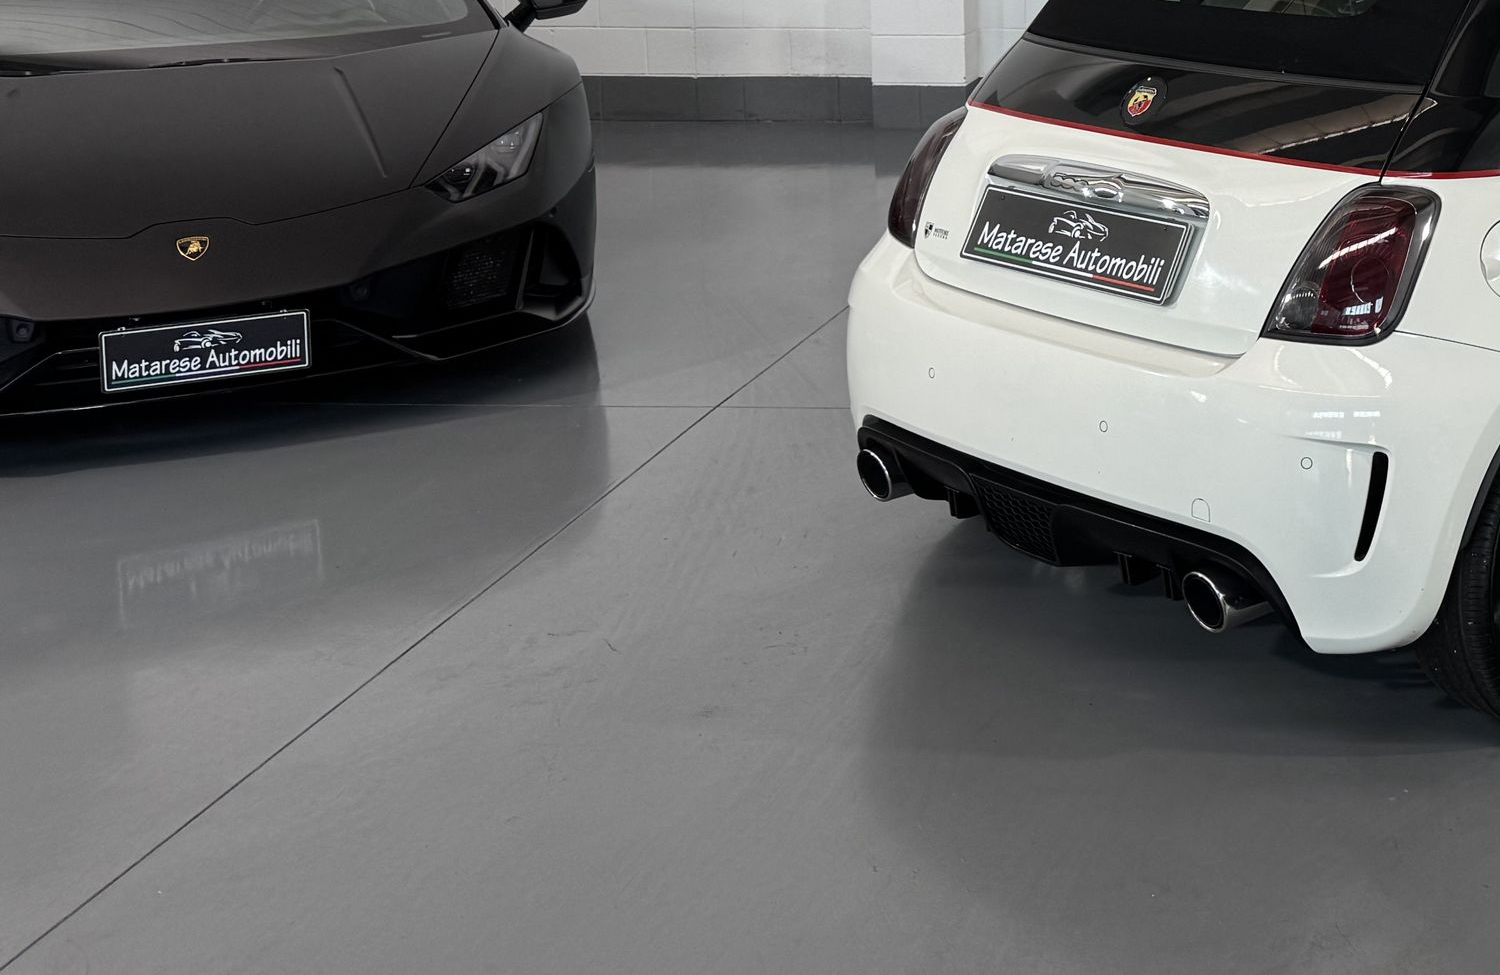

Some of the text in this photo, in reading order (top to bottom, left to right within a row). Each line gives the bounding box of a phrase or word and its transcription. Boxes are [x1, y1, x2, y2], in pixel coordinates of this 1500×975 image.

[977, 221, 1165, 285] Matarese Automobili
[111, 338, 301, 380] Matarese Automobili
